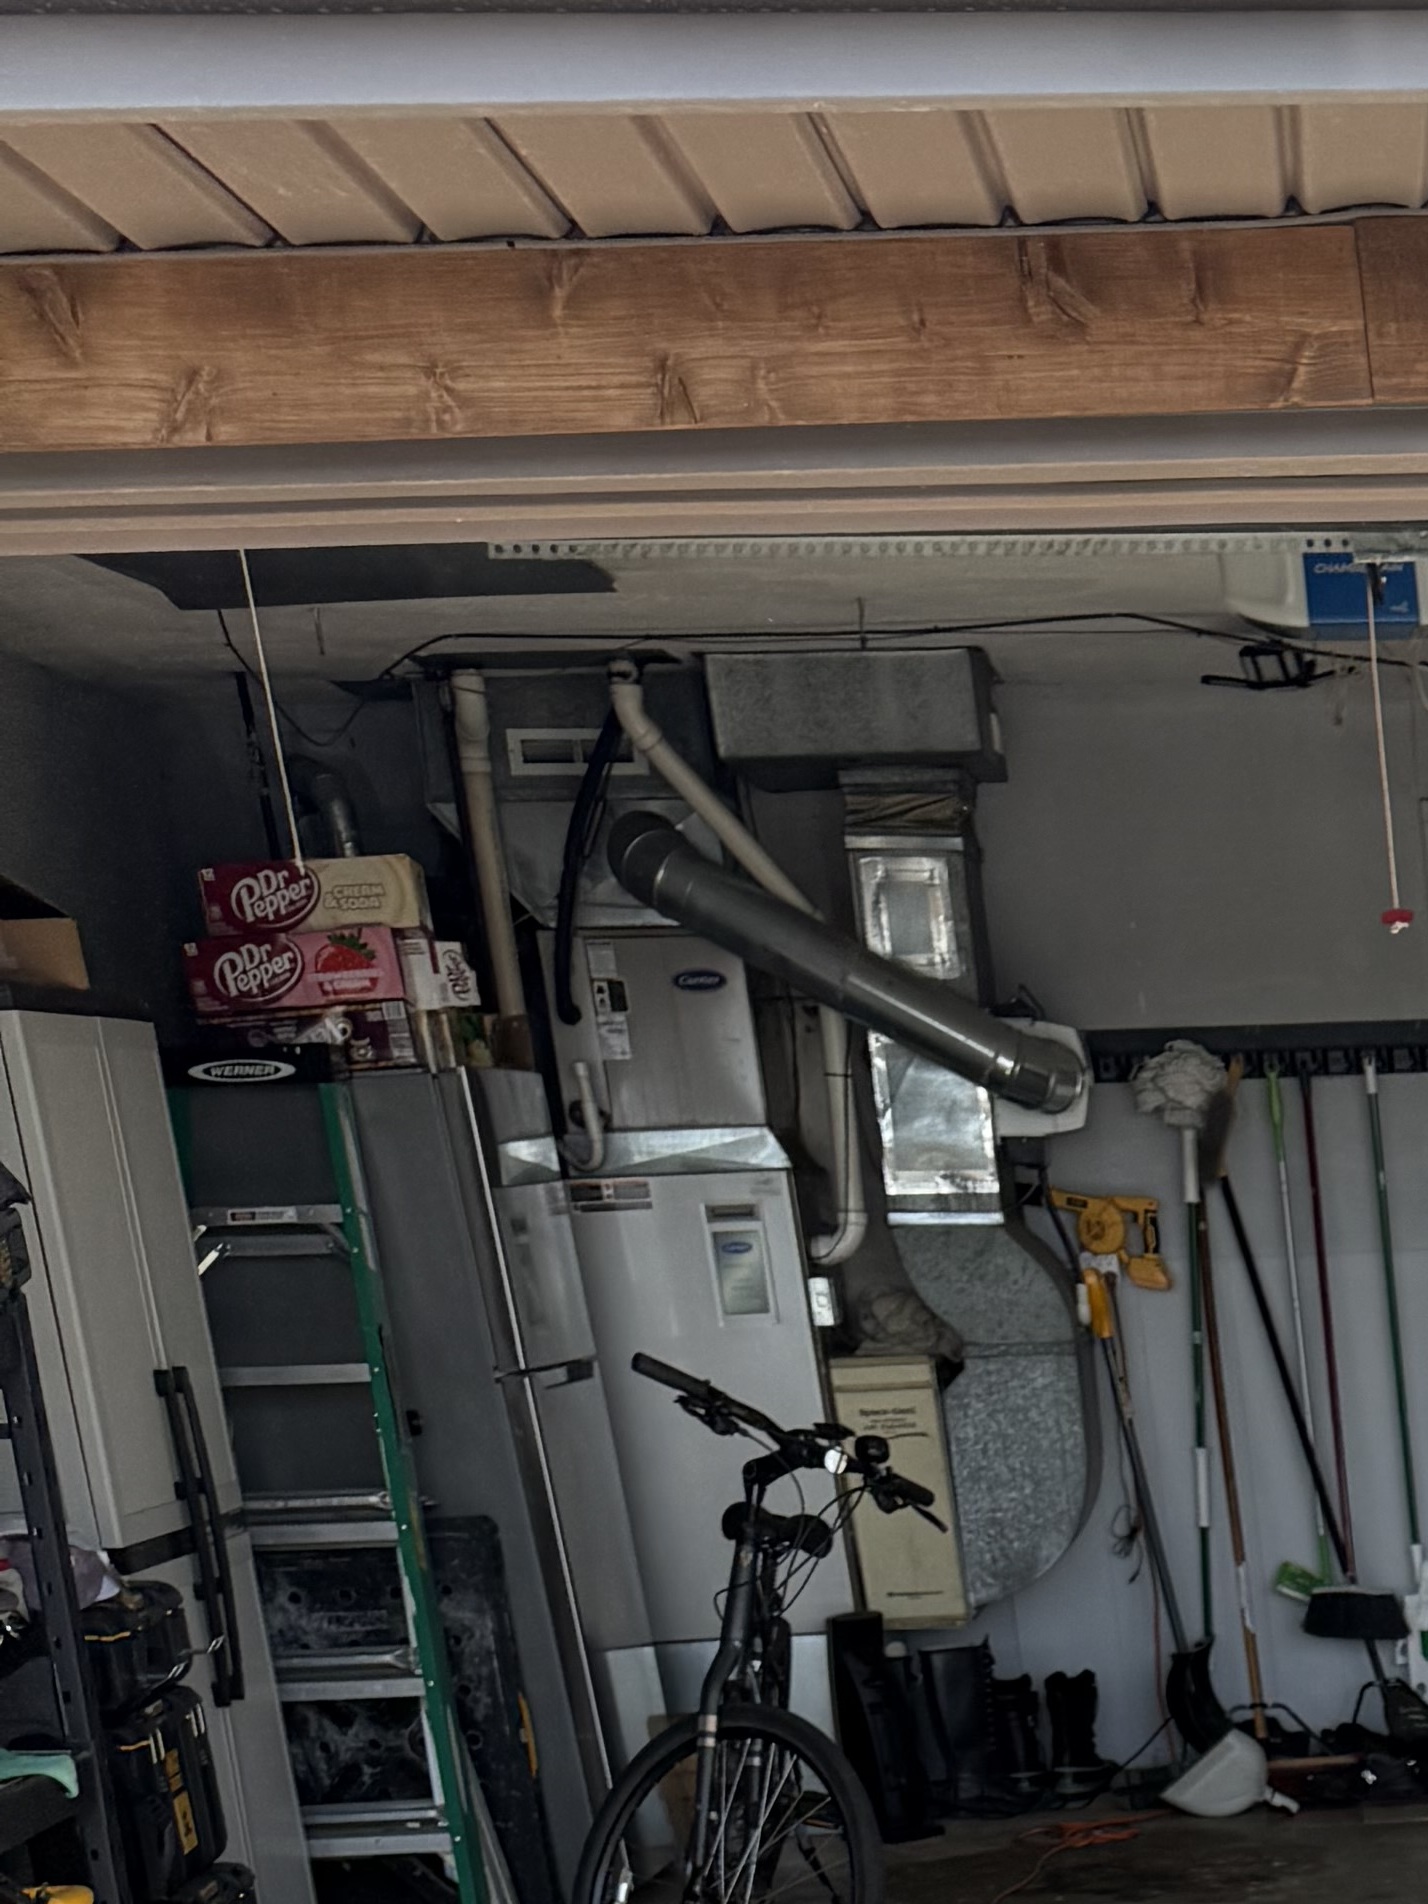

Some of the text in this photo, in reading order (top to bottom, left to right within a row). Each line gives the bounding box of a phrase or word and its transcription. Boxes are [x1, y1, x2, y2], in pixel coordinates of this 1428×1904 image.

[257, 868, 289, 891] Dr
[237, 876, 313, 923] Pepper
[334, 884, 385, 898] CREAM
[339, 896, 380, 910] SODA
[240, 943, 272, 965] Dr
[219, 951, 295, 998] Pepper
[209, 1064, 275, 1077] WERNER
